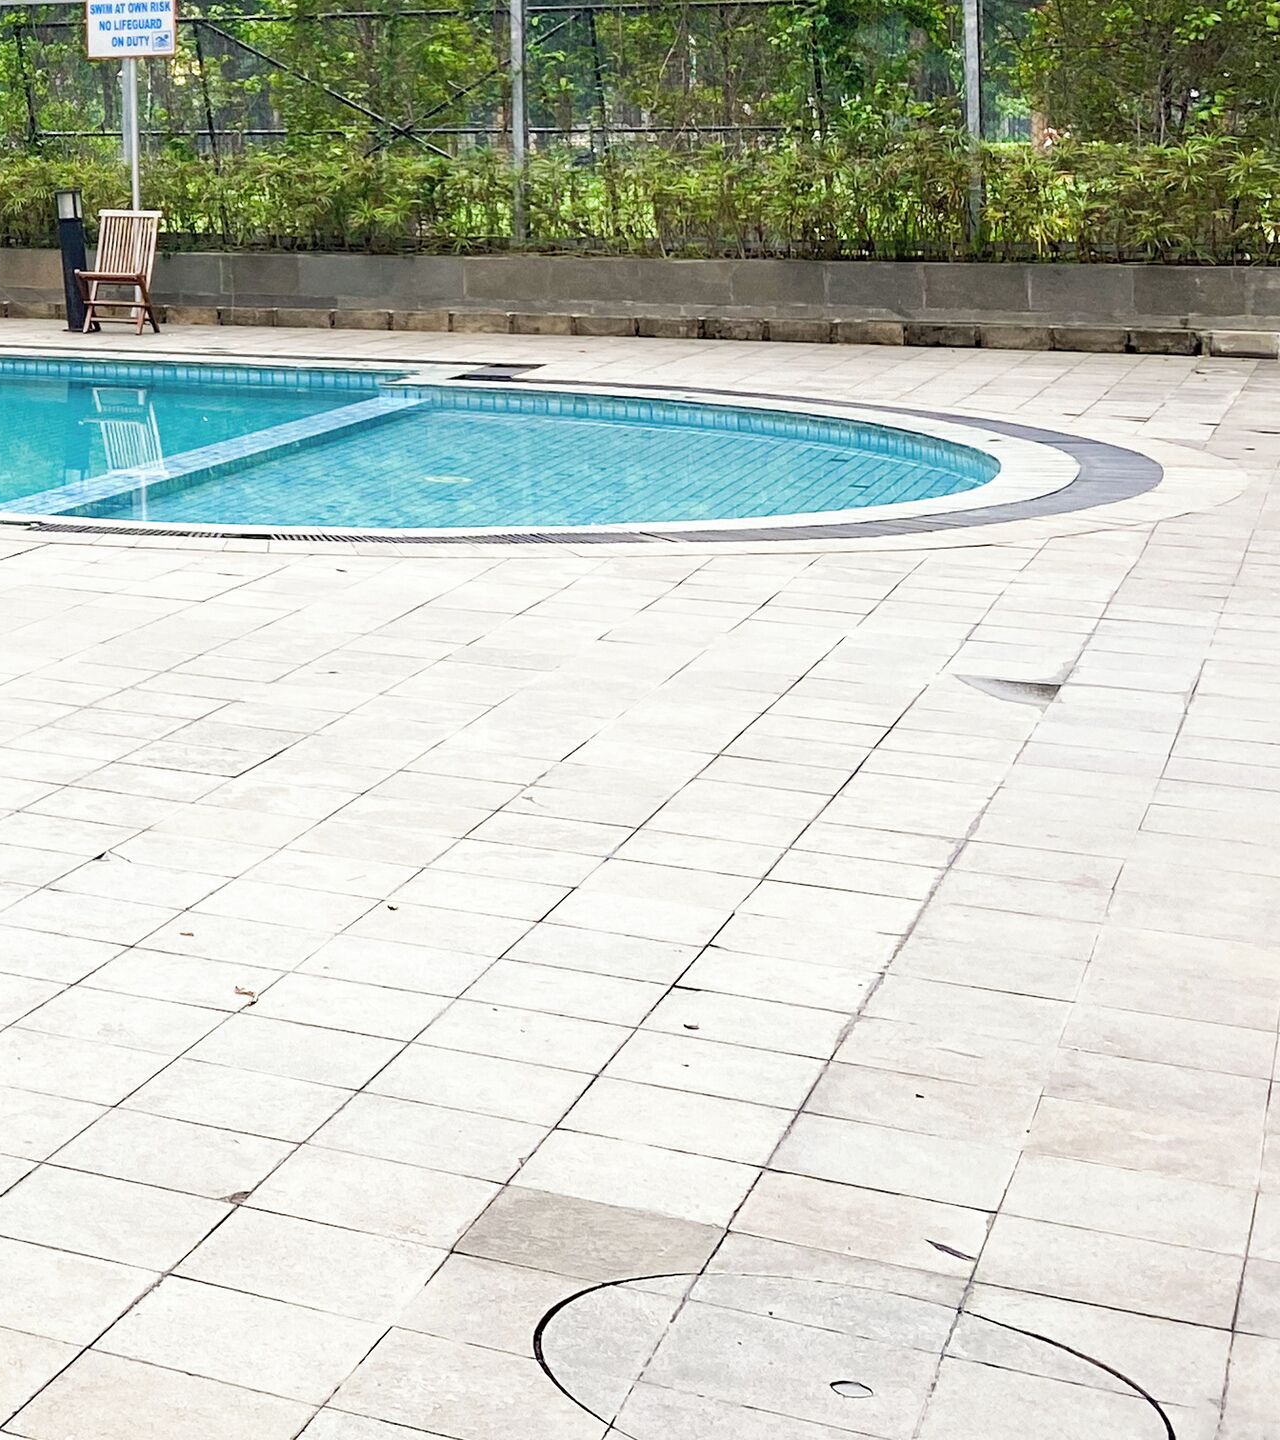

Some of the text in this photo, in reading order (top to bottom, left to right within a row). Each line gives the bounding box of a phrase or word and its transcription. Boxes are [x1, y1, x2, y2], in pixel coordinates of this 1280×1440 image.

[90, 1, 171, 14] SWIM AT OWN RISK
[99, 19, 162, 31] NO LIFEGUARD
[112, 36, 150, 47] ON DUTY
